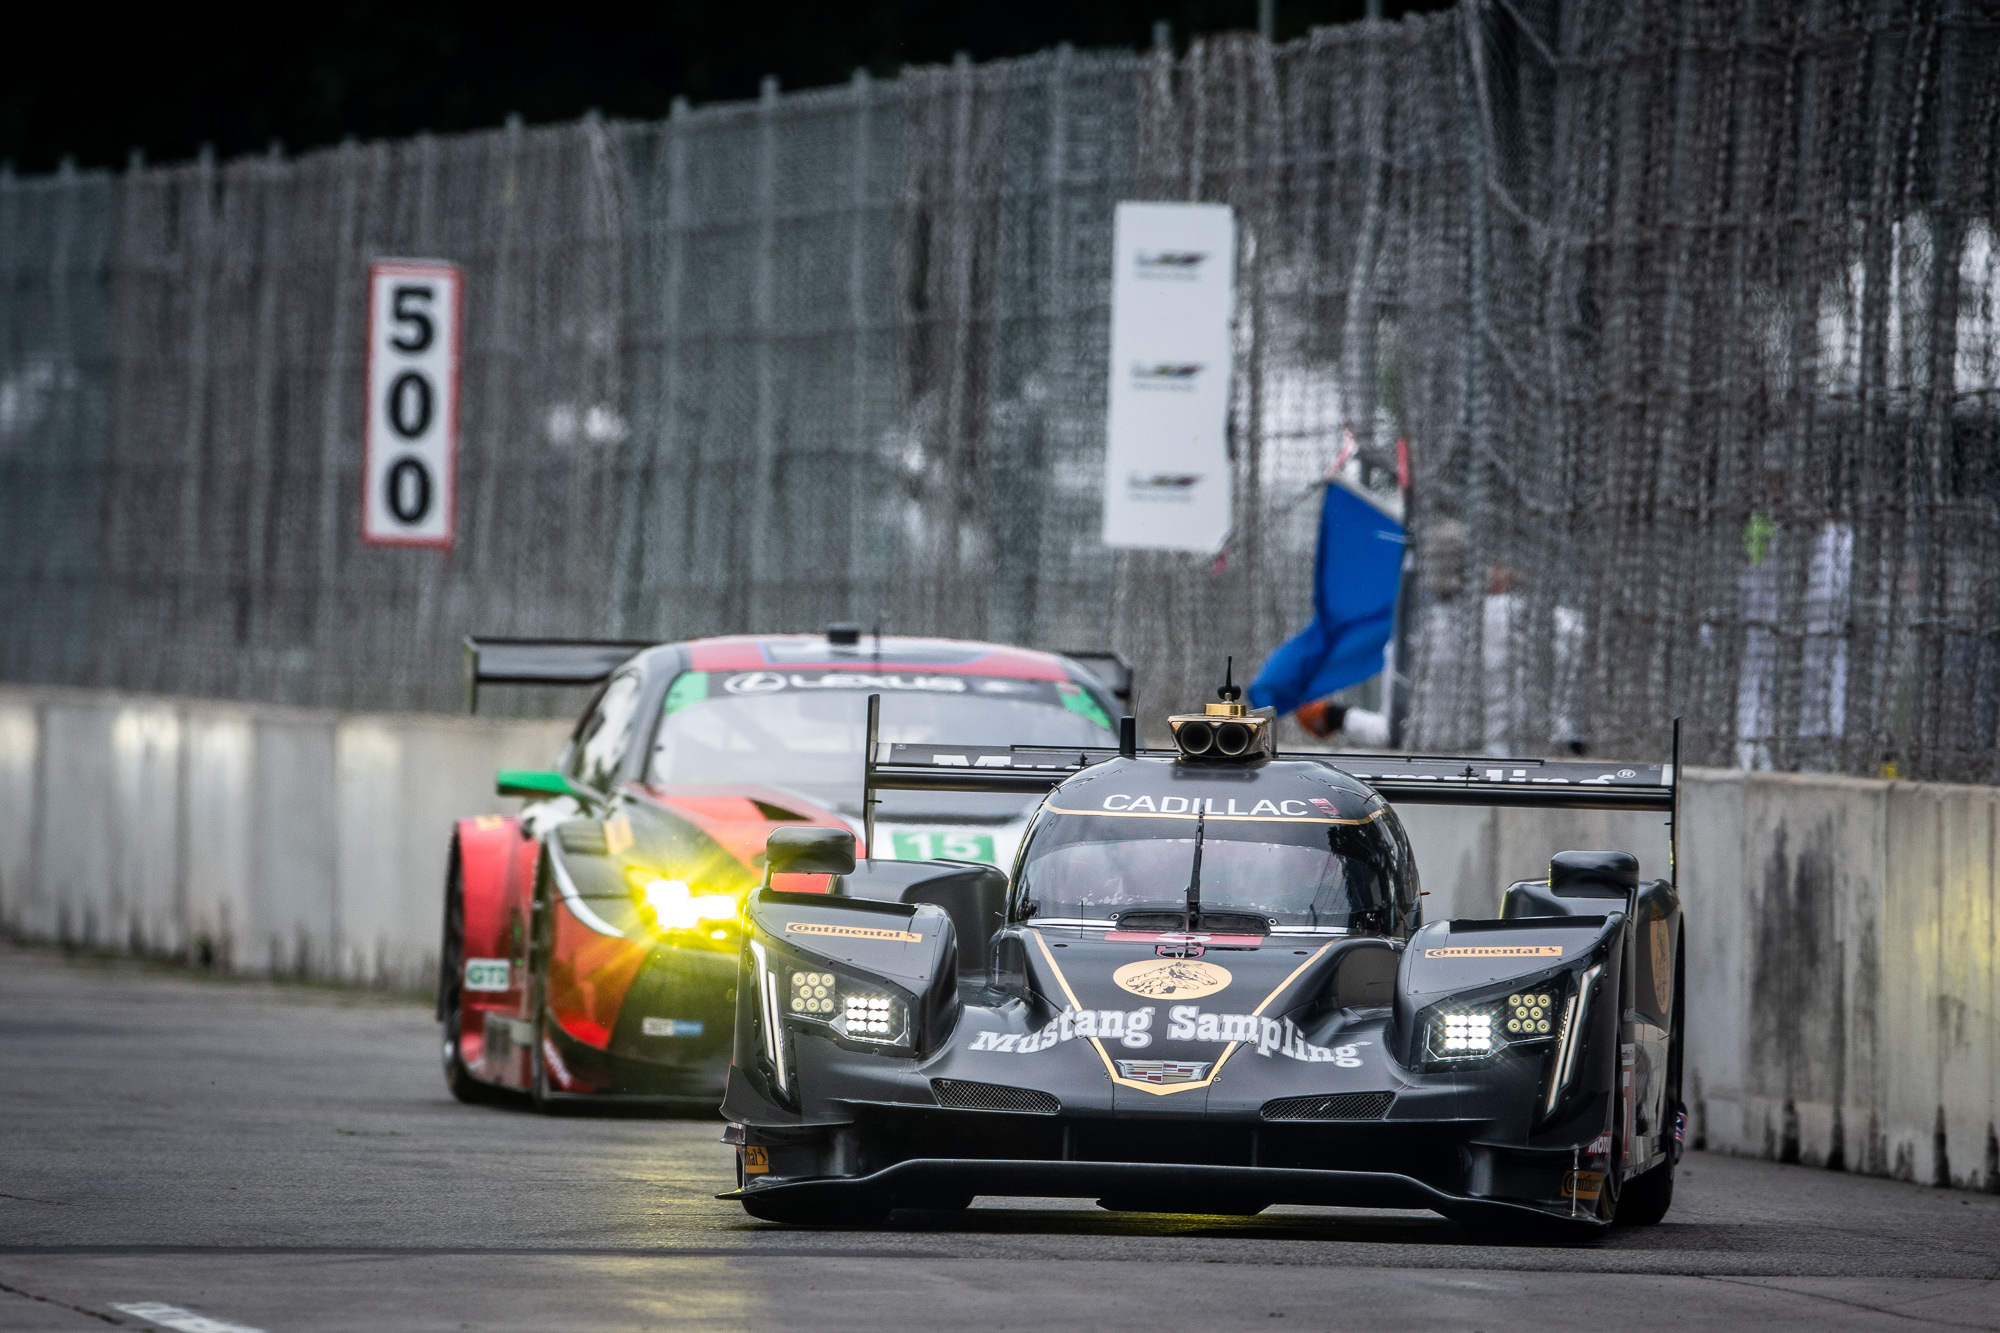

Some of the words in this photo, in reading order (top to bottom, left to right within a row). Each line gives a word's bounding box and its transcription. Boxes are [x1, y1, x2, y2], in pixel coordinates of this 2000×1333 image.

[386, 284, 435, 526] 500
[790, 673, 966, 693] LEXUS
[1102, 794, 1308, 816] CADILLAC
[905, 832, 983, 859] 15
[787, 923, 901, 938] Continental
[1427, 947, 1540, 957] Continental
[967, 1004, 1155, 1054] Mustang
[1167, 1005, 1364, 1068] Sampling
